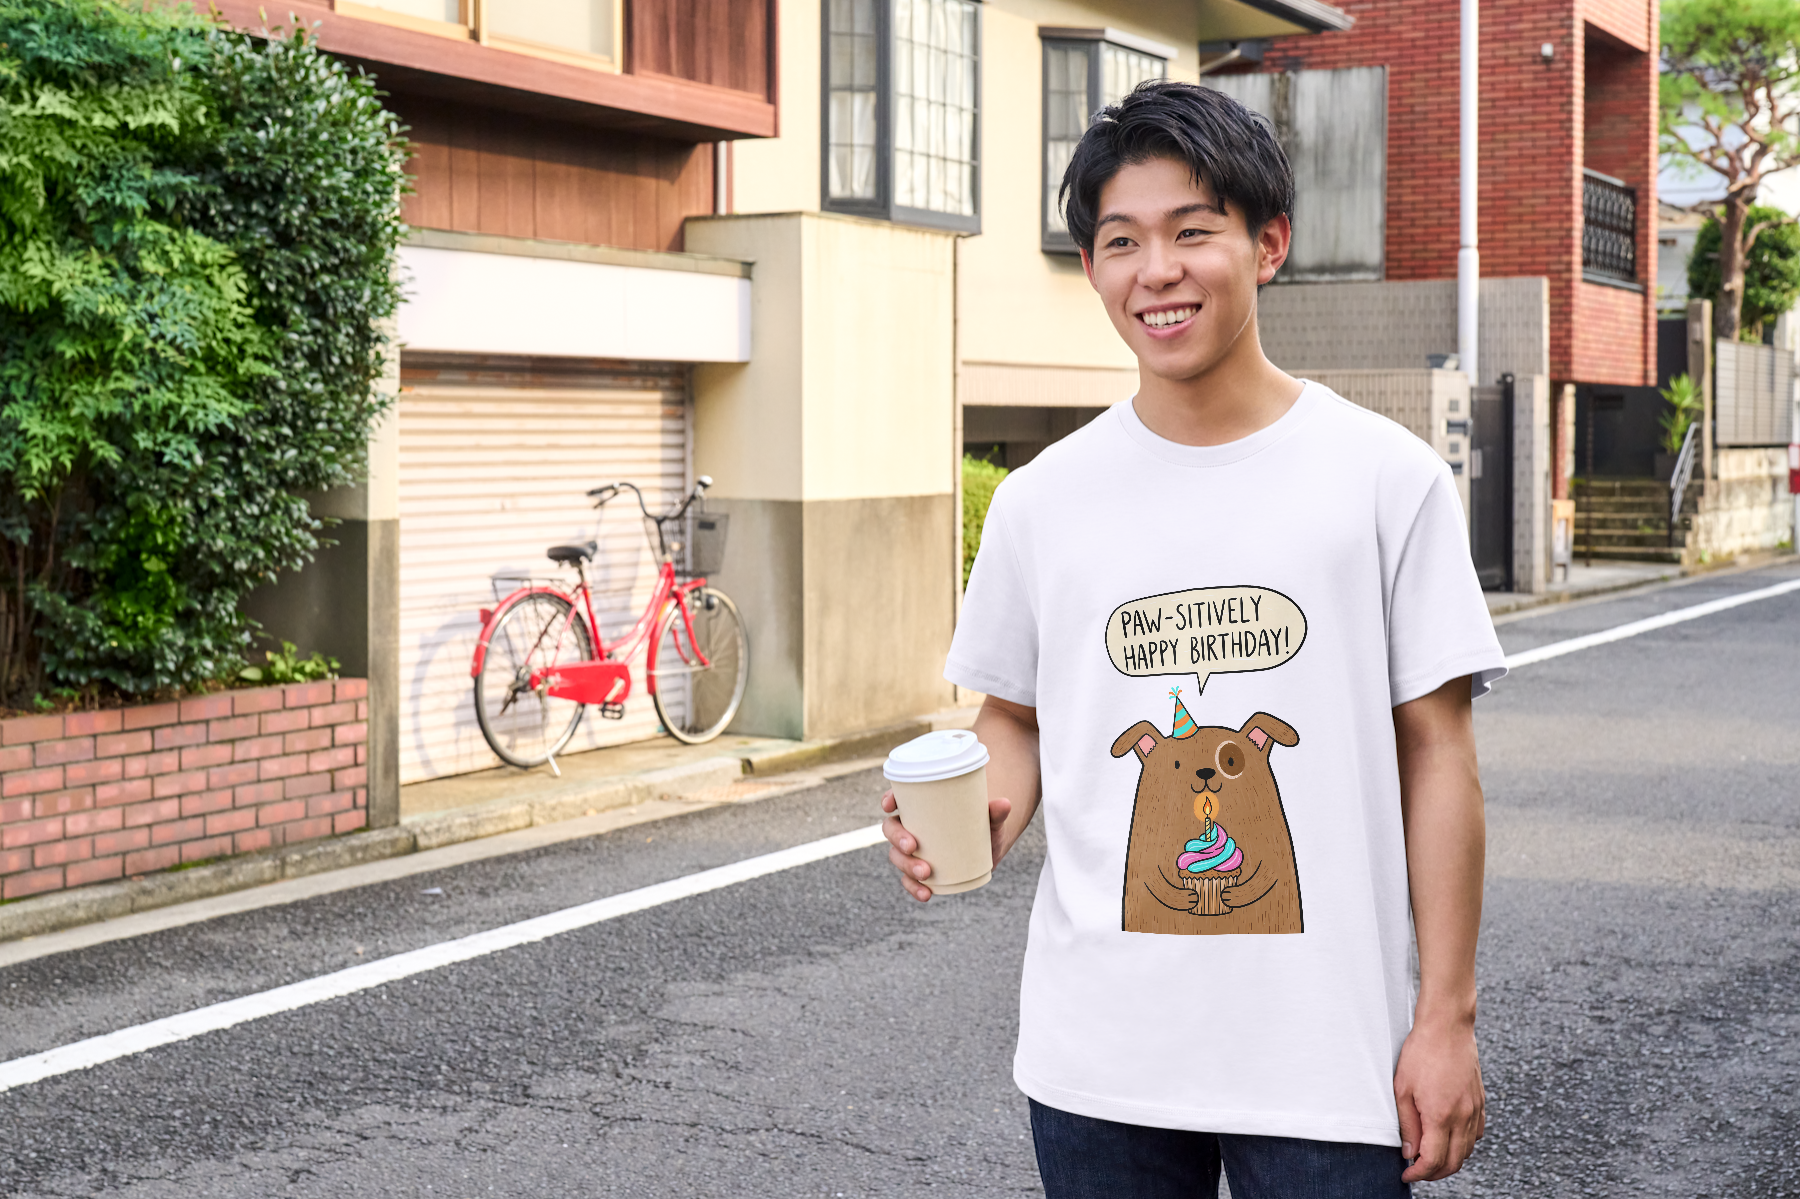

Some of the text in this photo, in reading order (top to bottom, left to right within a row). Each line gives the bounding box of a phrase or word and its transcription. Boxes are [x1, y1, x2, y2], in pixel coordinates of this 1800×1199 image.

[1121, 595, 1261, 638] PAW-SITIVELY
[1124, 626, 1289, 671] HAPPY BIRTHDAY!
